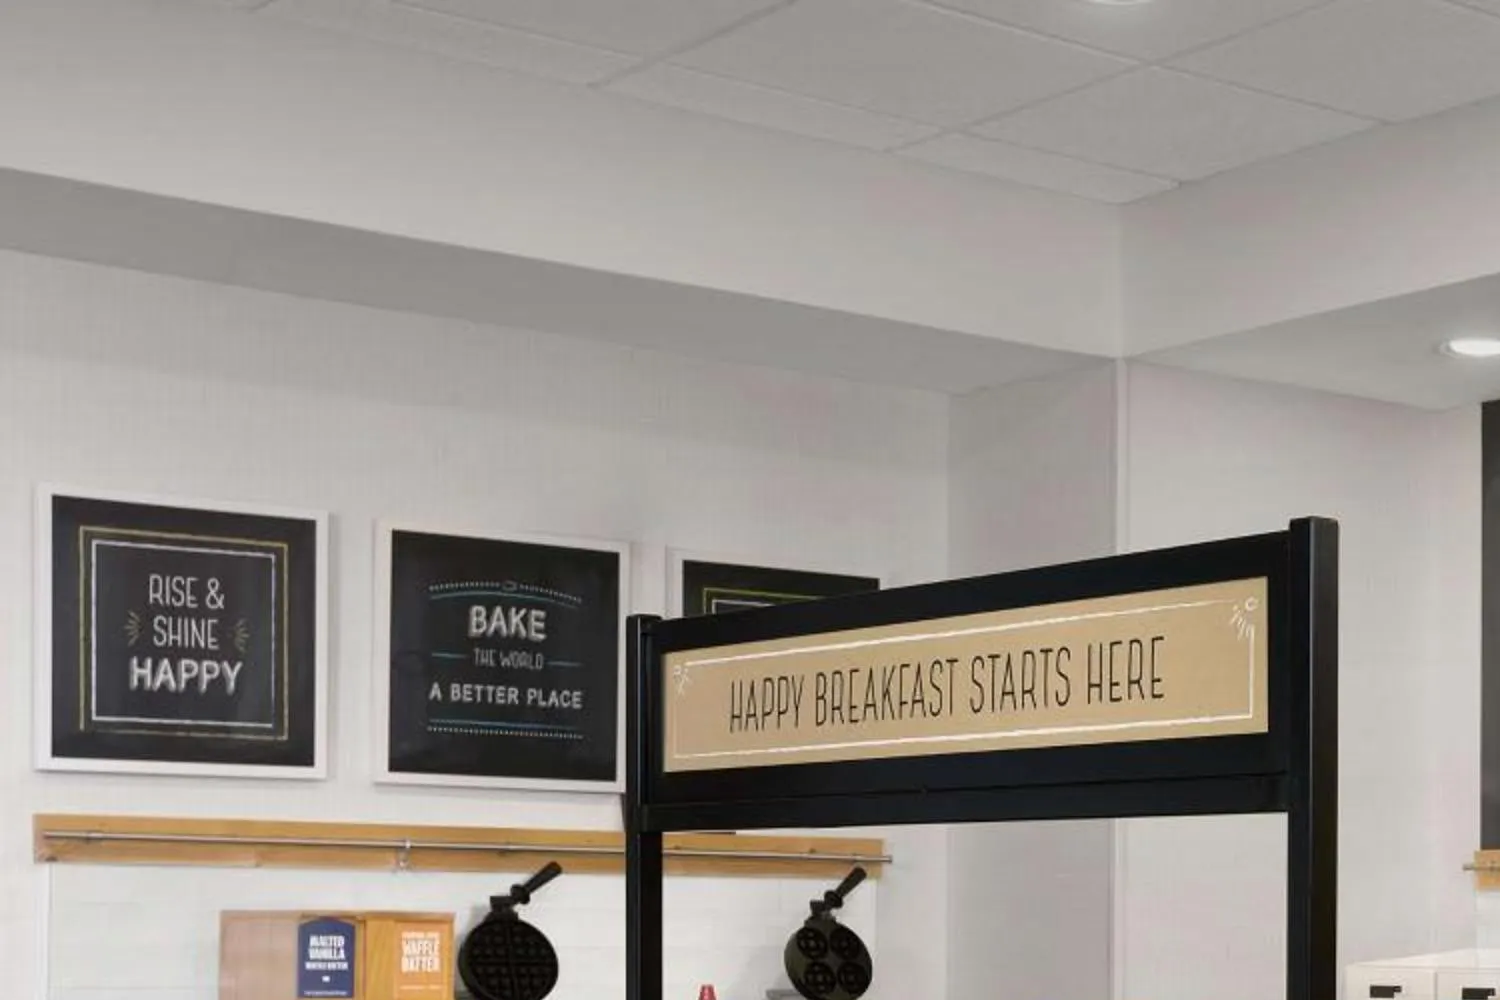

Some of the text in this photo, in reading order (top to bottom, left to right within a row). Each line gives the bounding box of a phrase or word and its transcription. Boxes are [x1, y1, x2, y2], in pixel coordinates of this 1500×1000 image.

[148, 574, 224, 609] RISE &
[153, 615, 219, 650] SHINE
[468, 605, 547, 642] BAKE
[474, 648, 544, 669] THE WORLD
[129, 656, 243, 696] HAPPY
[729, 635, 1166, 733] HAPPY BREAKFAST STARTS HERE
[428, 682, 583, 709] A BETTER PLACE
[308, 948, 345, 960] VANILLA
[402, 939, 439, 956] WAFFLE
[401, 956, 440, 973] BATTER
